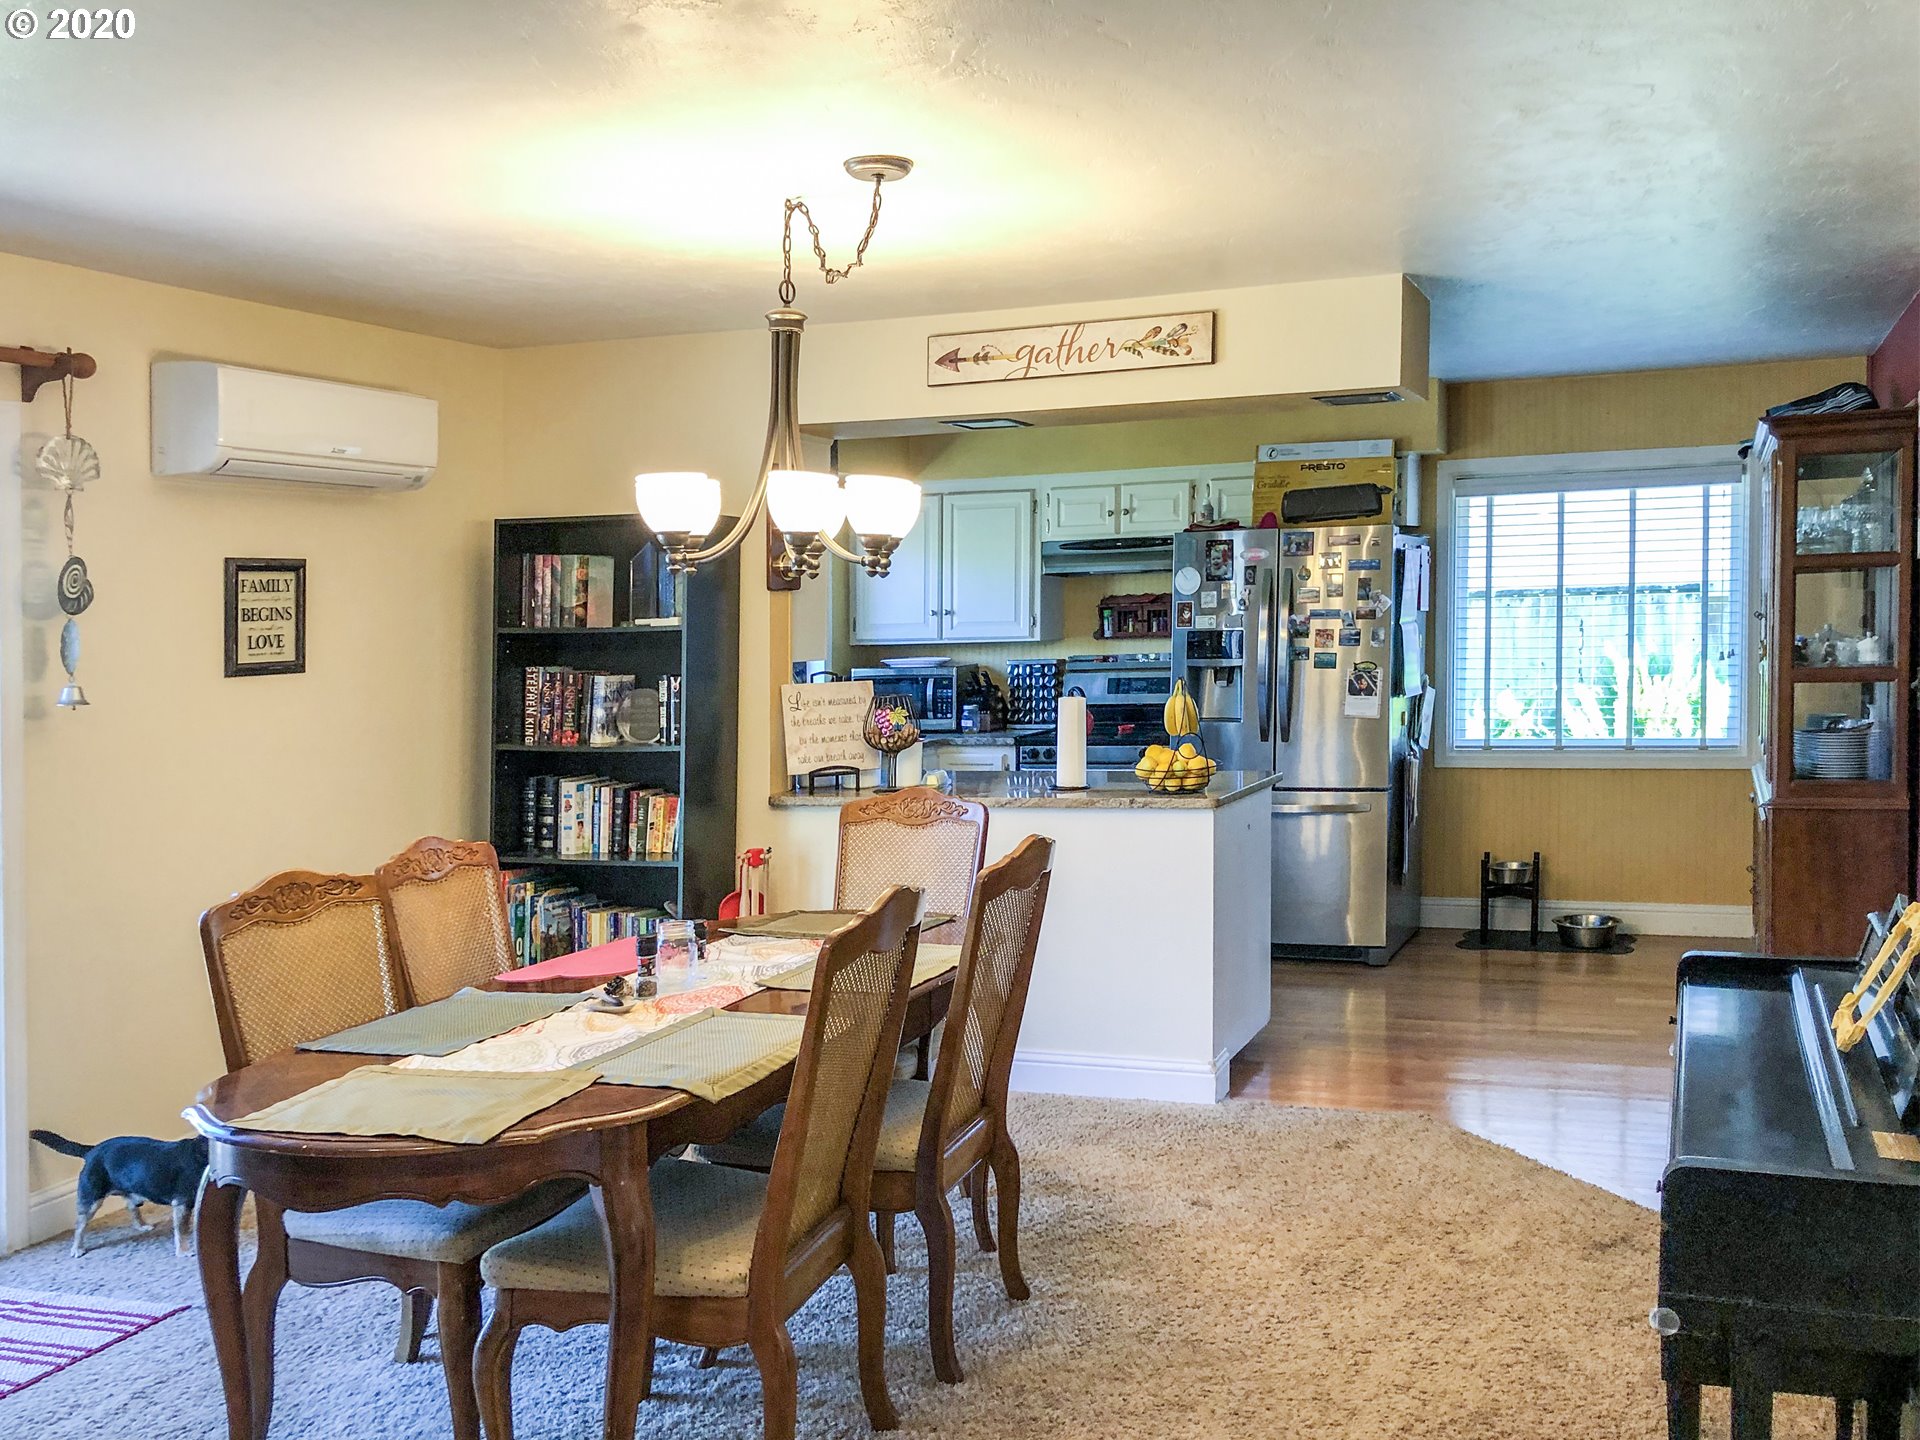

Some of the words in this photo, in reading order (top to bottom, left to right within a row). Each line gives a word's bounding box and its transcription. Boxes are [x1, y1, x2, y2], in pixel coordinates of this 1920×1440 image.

[1005, 323, 1120, 380] gather
[1300, 462, 1346, 473] PRESTO
[240, 578, 294, 593] FAMILY
[241, 606, 293, 622] BEGINS
[247, 634, 285, 650] LOVE
[525, 666, 539, 715] STEPHEN
[525, 717, 535, 743] KING
